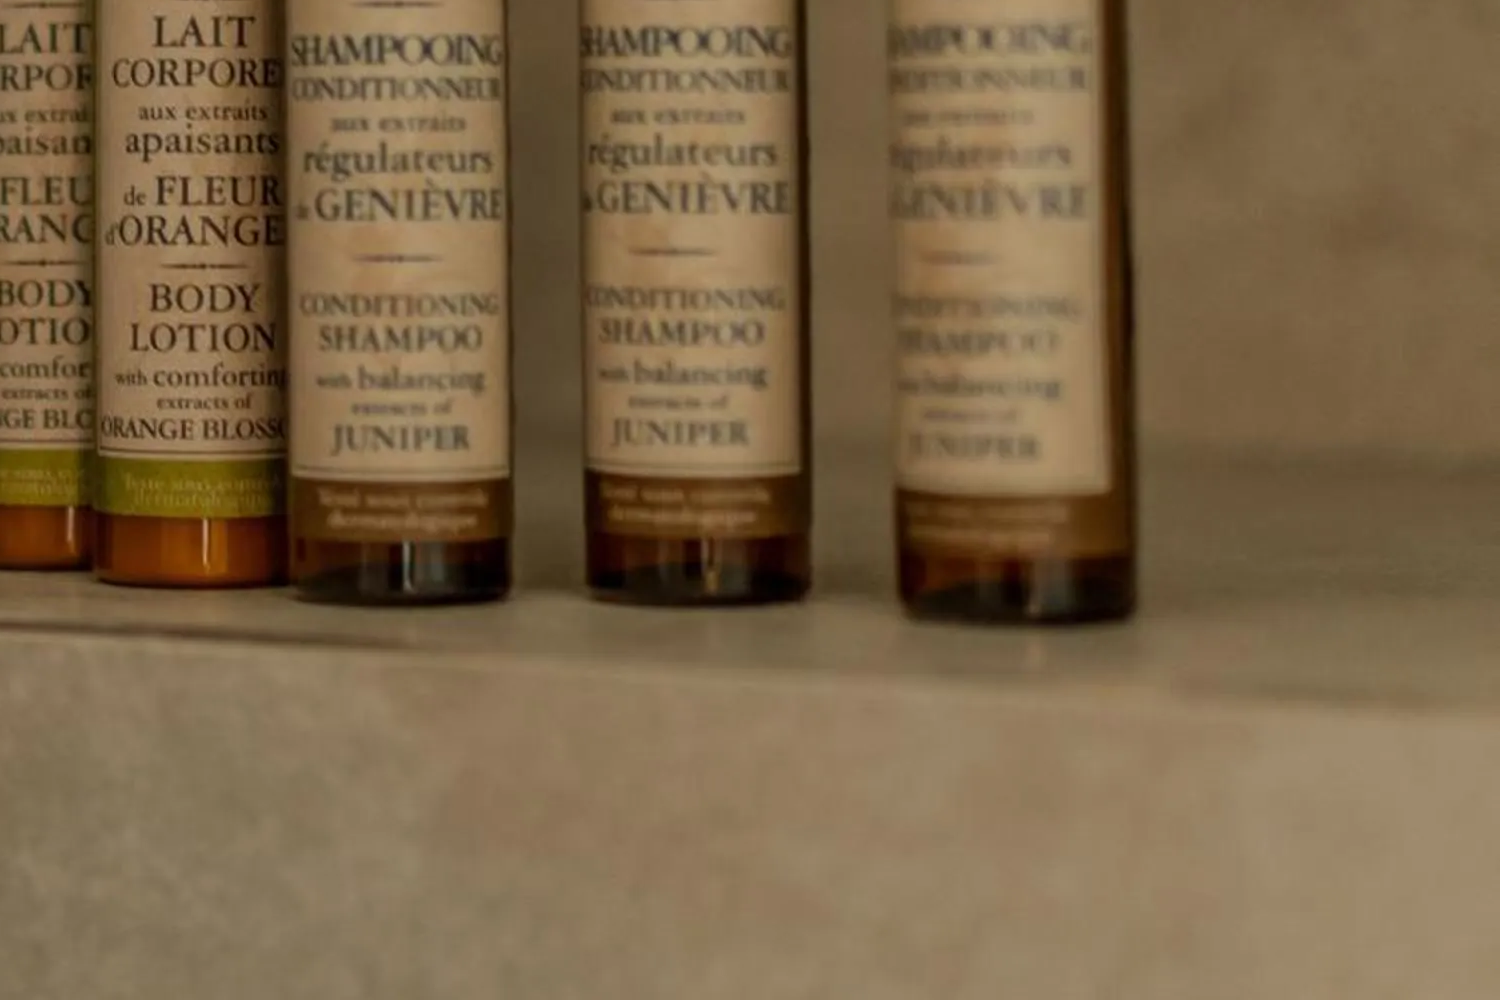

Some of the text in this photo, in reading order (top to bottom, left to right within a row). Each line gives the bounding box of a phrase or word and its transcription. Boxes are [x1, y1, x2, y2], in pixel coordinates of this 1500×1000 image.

[151, 15, 255, 50] LAIT
[290, 31, 503, 68] SHAMPOOING
[111, 56, 284, 89] CORPORE
[137, 98, 268, 122] aux extraits
[124, 122, 280, 163] apaisants
[587, 131, 779, 174] régulateurs
[303, 137, 493, 183] régulateurs
[123, 173, 285, 207] de FLEUR
[313, 175, 502, 222] GENIÈVRE
[149, 282, 261, 314] BODY
[298, 291, 499, 318] CONDITIONING
[130, 321, 278, 354] LOTION
[318, 323, 484, 354] SHAMPOO
[597, 317, 766, 347] SHAMPOO
[114, 372, 147, 387] with
[357, 362, 488, 397] balancing
[156, 391, 253, 411] extracts of
[100, 415, 194, 441] ORANGE
[329, 422, 472, 457] JUNIPER
[611, 417, 750, 448] JUNIPER
